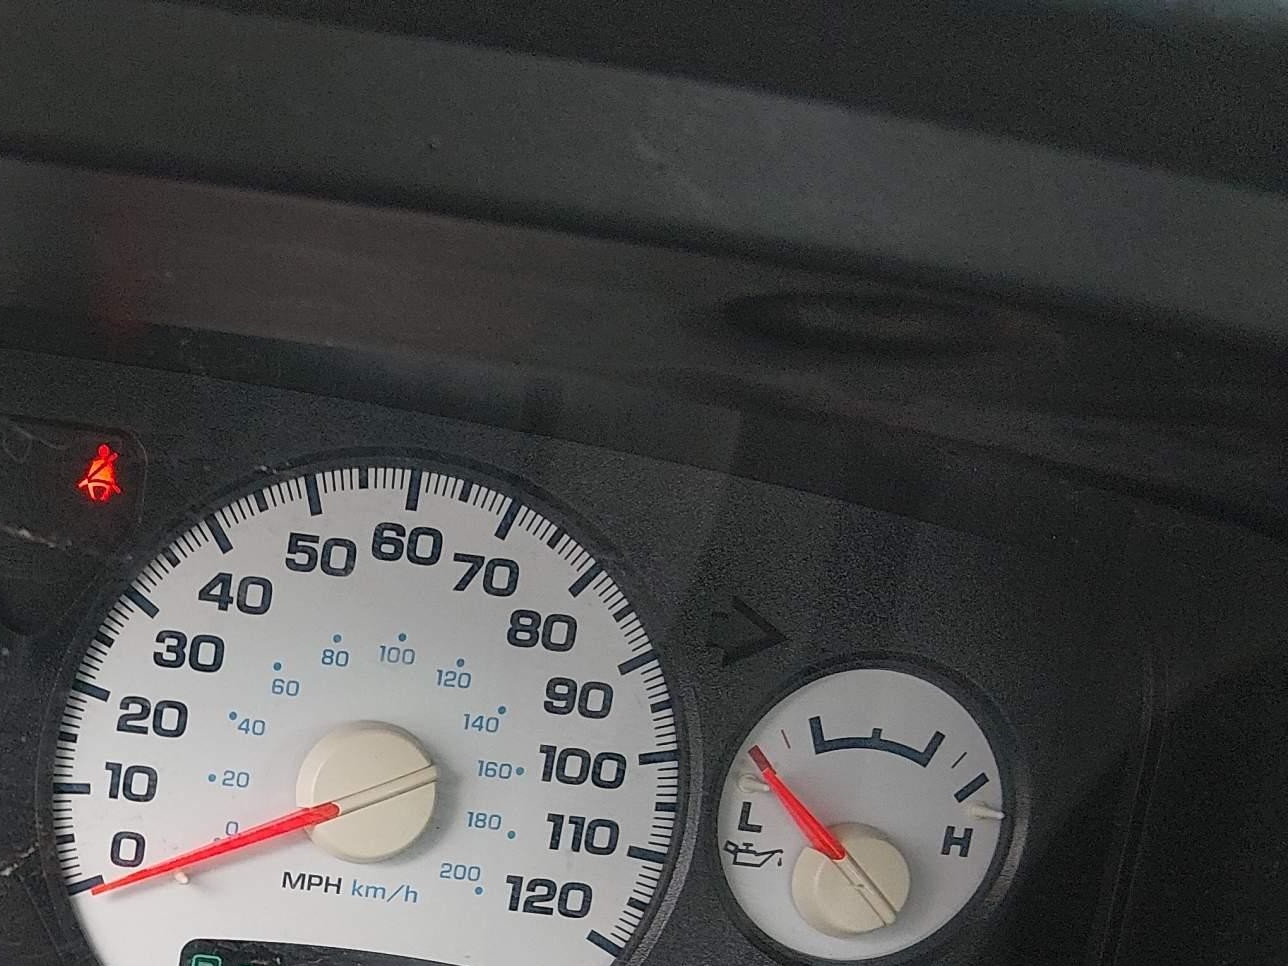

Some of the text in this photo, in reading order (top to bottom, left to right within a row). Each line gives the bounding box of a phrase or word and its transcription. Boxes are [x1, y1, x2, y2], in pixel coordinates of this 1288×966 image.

[286, 532, 356, 576] 50
[372, 522, 443, 566] 60
[453, 553, 519, 597] 70
[198, 573, 272, 615] 40
[507, 610, 577, 652] 80
[153, 630, 224, 672] 30
[321, 648, 350, 668] 80
[379, 645, 415, 665] 100
[271, 678, 300, 697] 60
[436, 668, 472, 689] 120
[544, 677, 613, 719] 90
[117, 696, 188, 737] 20
[237, 718, 266, 736] 40
[463, 713, 500, 733] 140
[105, 762, 157, 802] 10
[221, 769, 250, 788] 20
[477, 759, 513, 780] 160
[540, 745, 626, 789] 100
[226, 821, 239, 836] 0
[467, 811, 502, 831] 180
[547, 813, 619, 855] 110
[738, 802, 762, 833] L
[111, 832, 146, 868] 0
[941, 826, 973, 857] H
[281, 871, 418, 904] MPH km/h
[439, 862, 482, 882] 200
[506, 875, 592, 918] 120
